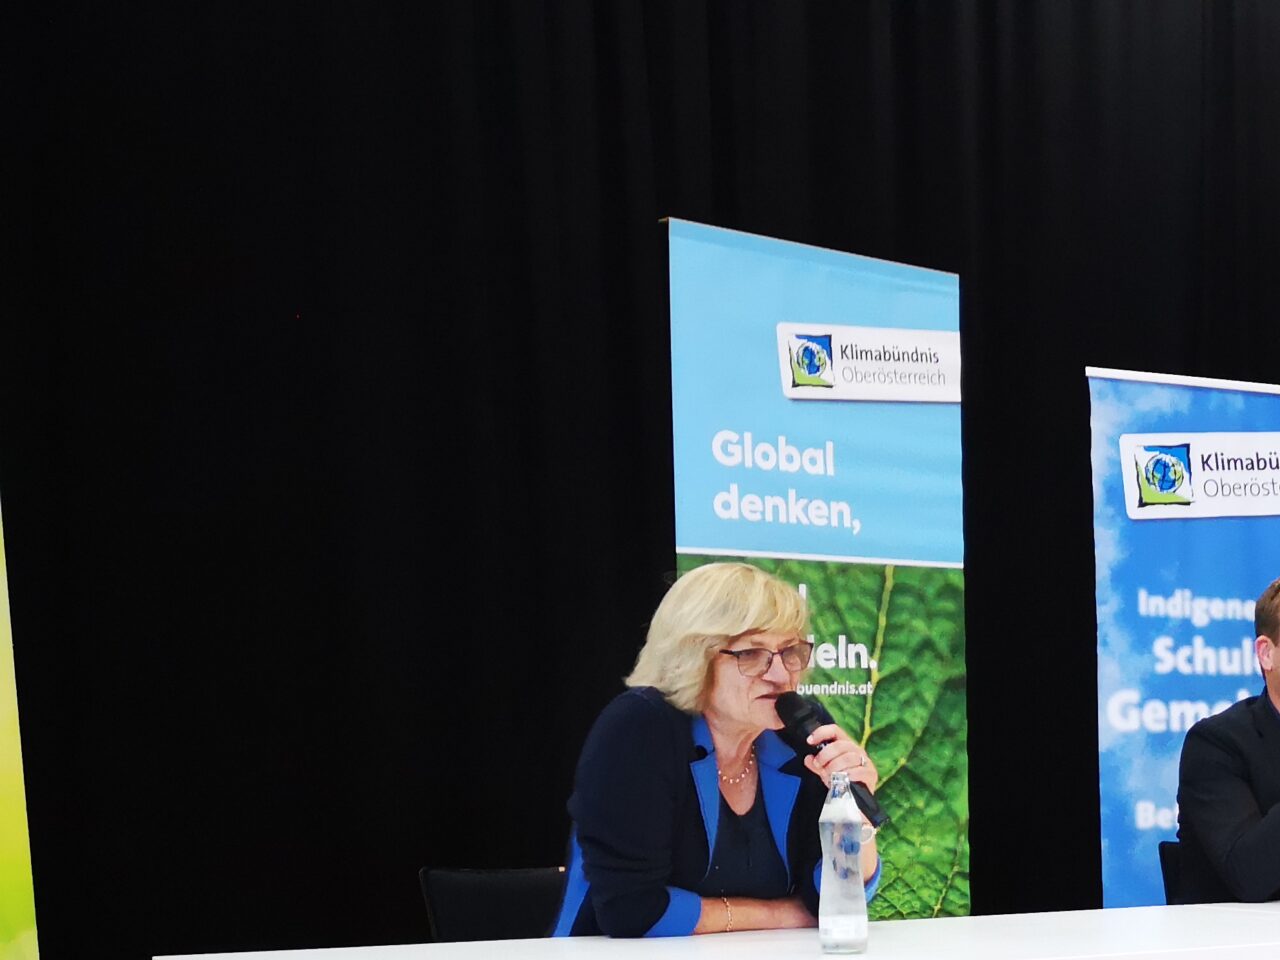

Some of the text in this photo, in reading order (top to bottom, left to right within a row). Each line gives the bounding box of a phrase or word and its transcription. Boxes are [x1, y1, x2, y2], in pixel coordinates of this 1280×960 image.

[840, 344, 940, 363] Klimabündnis
[841, 365, 947, 386] Oberösterreich
[711, 429, 835, 477] Global
[713, 483, 862, 536] denken,
[1152, 635, 1263, 676] Schul
[796, 680, 874, 696] buendnis.at
